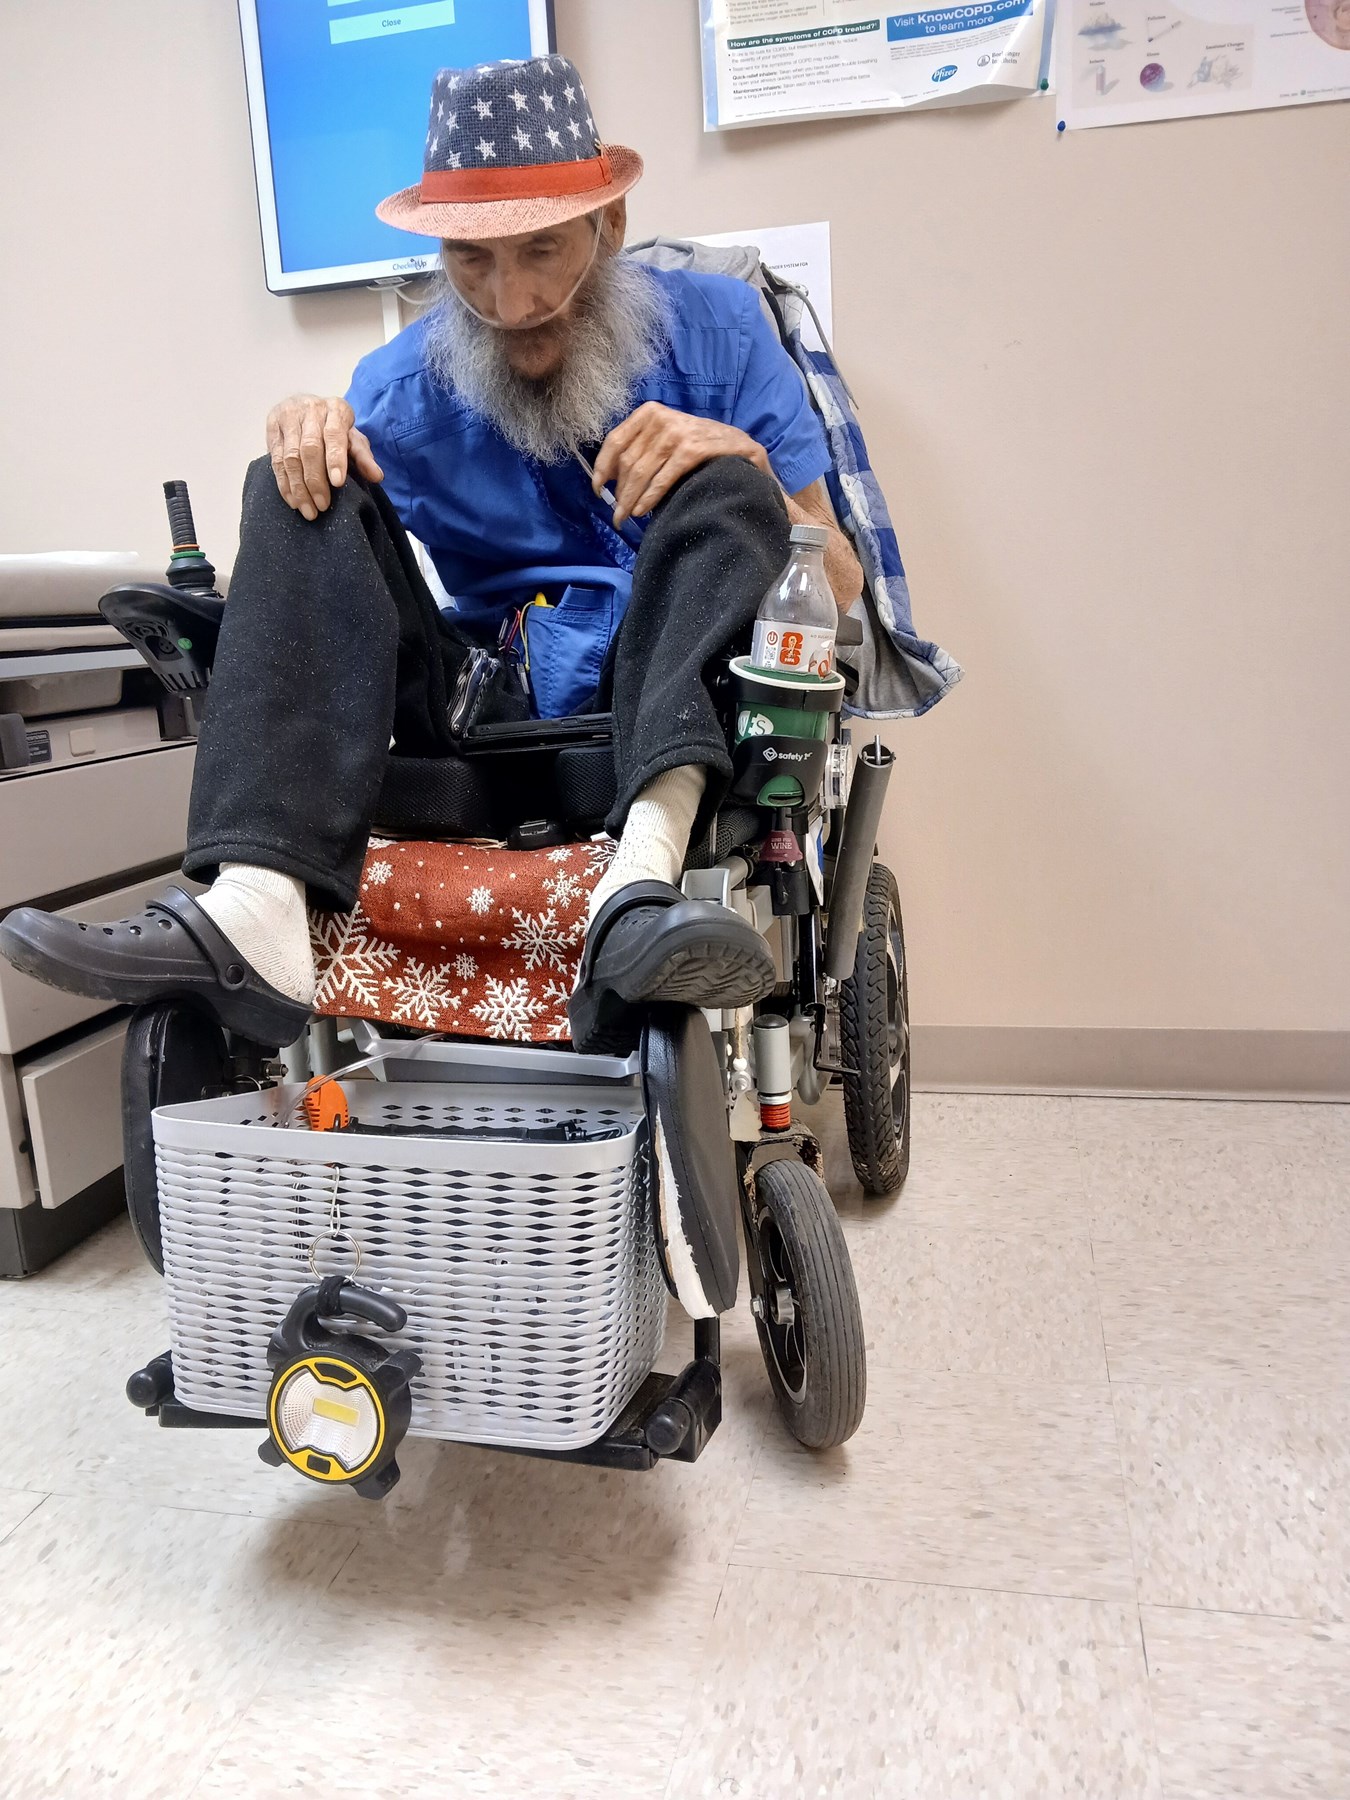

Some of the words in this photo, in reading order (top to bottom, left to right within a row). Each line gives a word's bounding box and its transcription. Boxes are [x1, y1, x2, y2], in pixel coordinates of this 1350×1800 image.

[894, 18, 914, 28] Visit
[918, 0, 1026, 24] KnowCOPD.com
[382, 18, 402, 28] Close
[926, 25, 936, 34] to
[938, 22, 964, 32] learn
[967, 14, 994, 27] more
[775, 32, 812, 43] symptoms
[822, 28, 843, 36] COPD
[932, 67, 958, 82] Pfizer
[778, 752, 803, 762] safety
